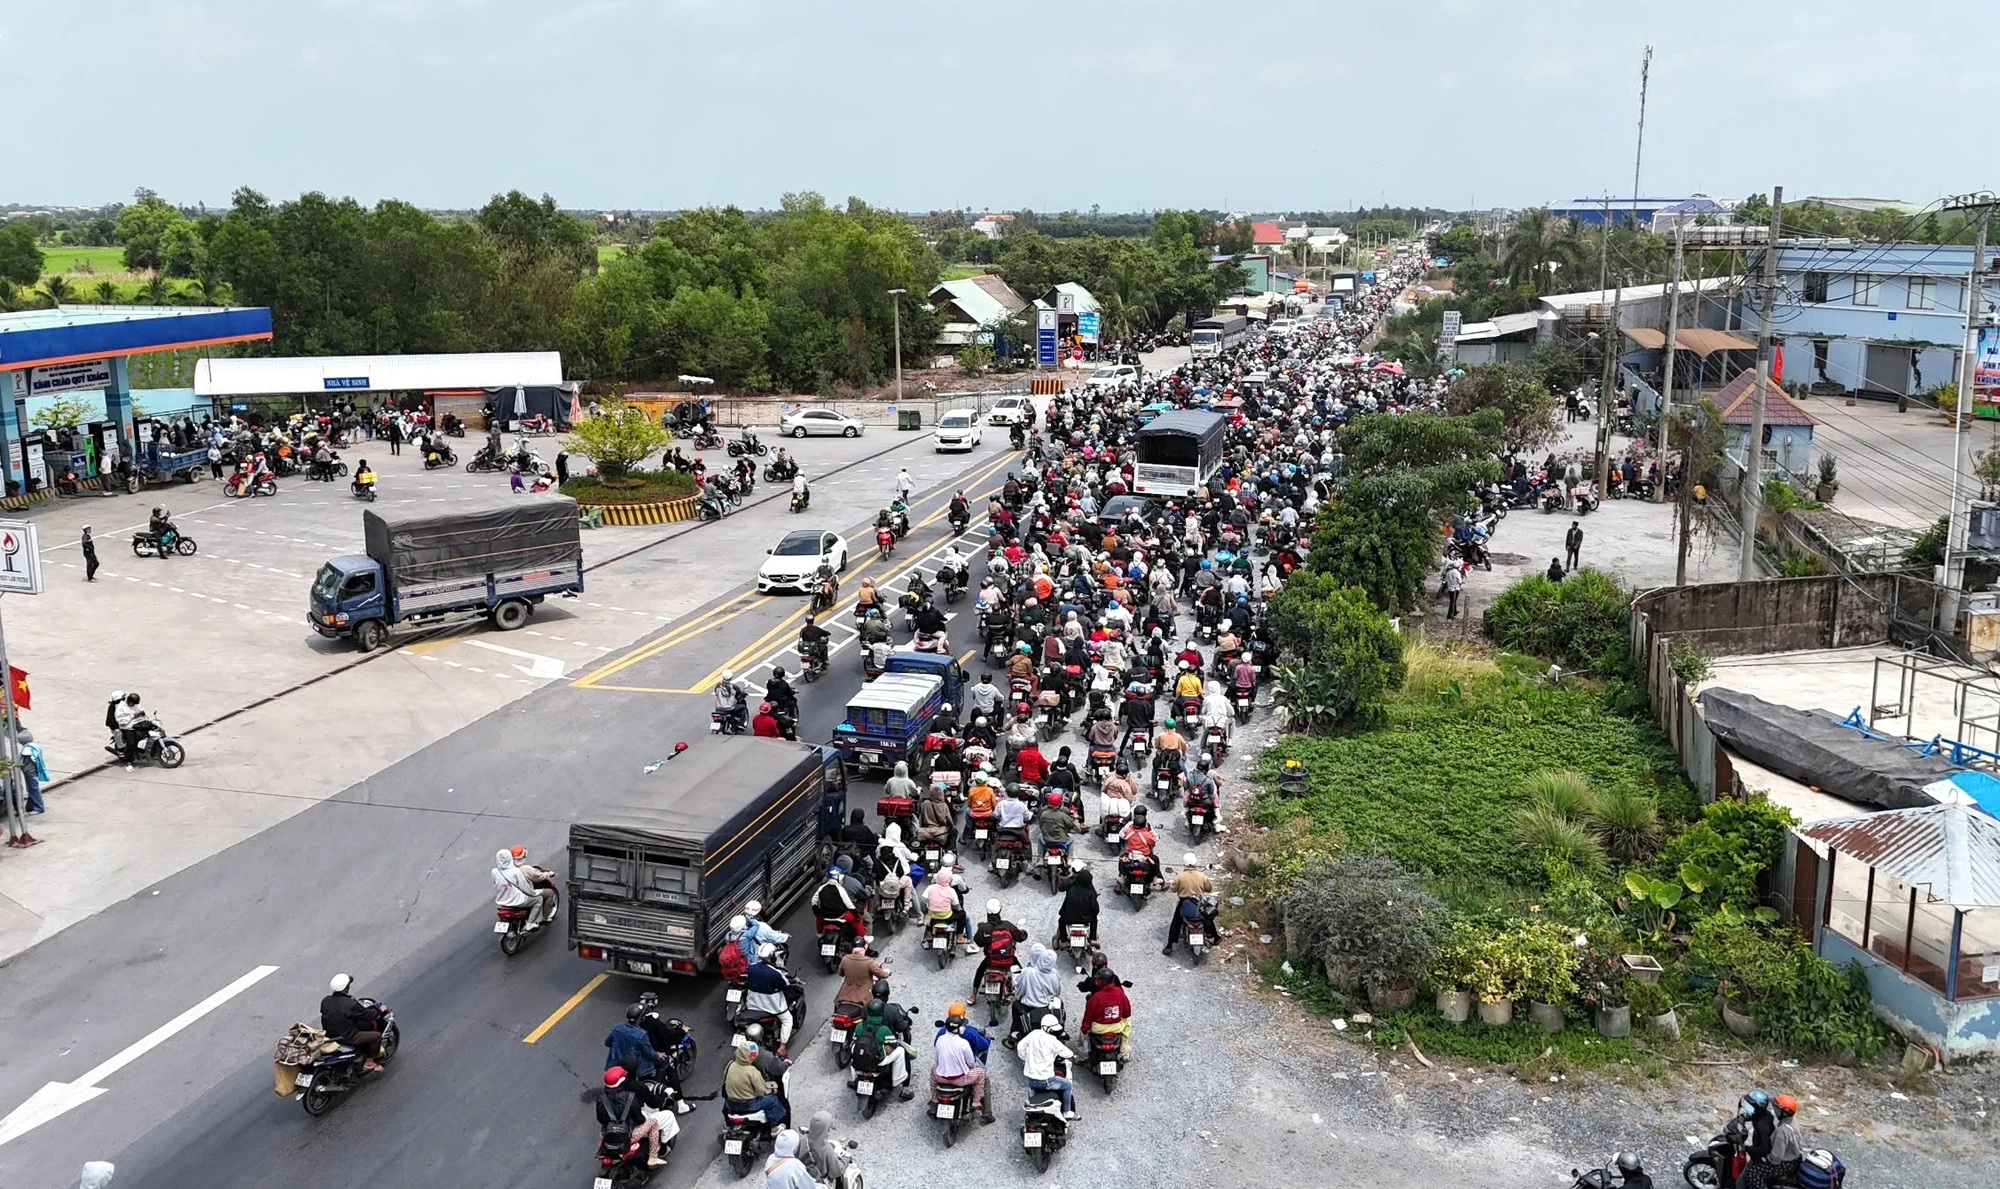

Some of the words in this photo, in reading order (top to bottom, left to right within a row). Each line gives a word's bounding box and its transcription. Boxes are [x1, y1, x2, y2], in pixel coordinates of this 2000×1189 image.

[33, 379, 51, 390] KÍNH
[51, 376, 71, 387] CHÀO
[72, 374, 86, 385] QUÝ
[87, 371, 109, 382] KHÁCH
[326, 379, 341, 387] NHÀ
[341, 379, 351, 387] VỆ
